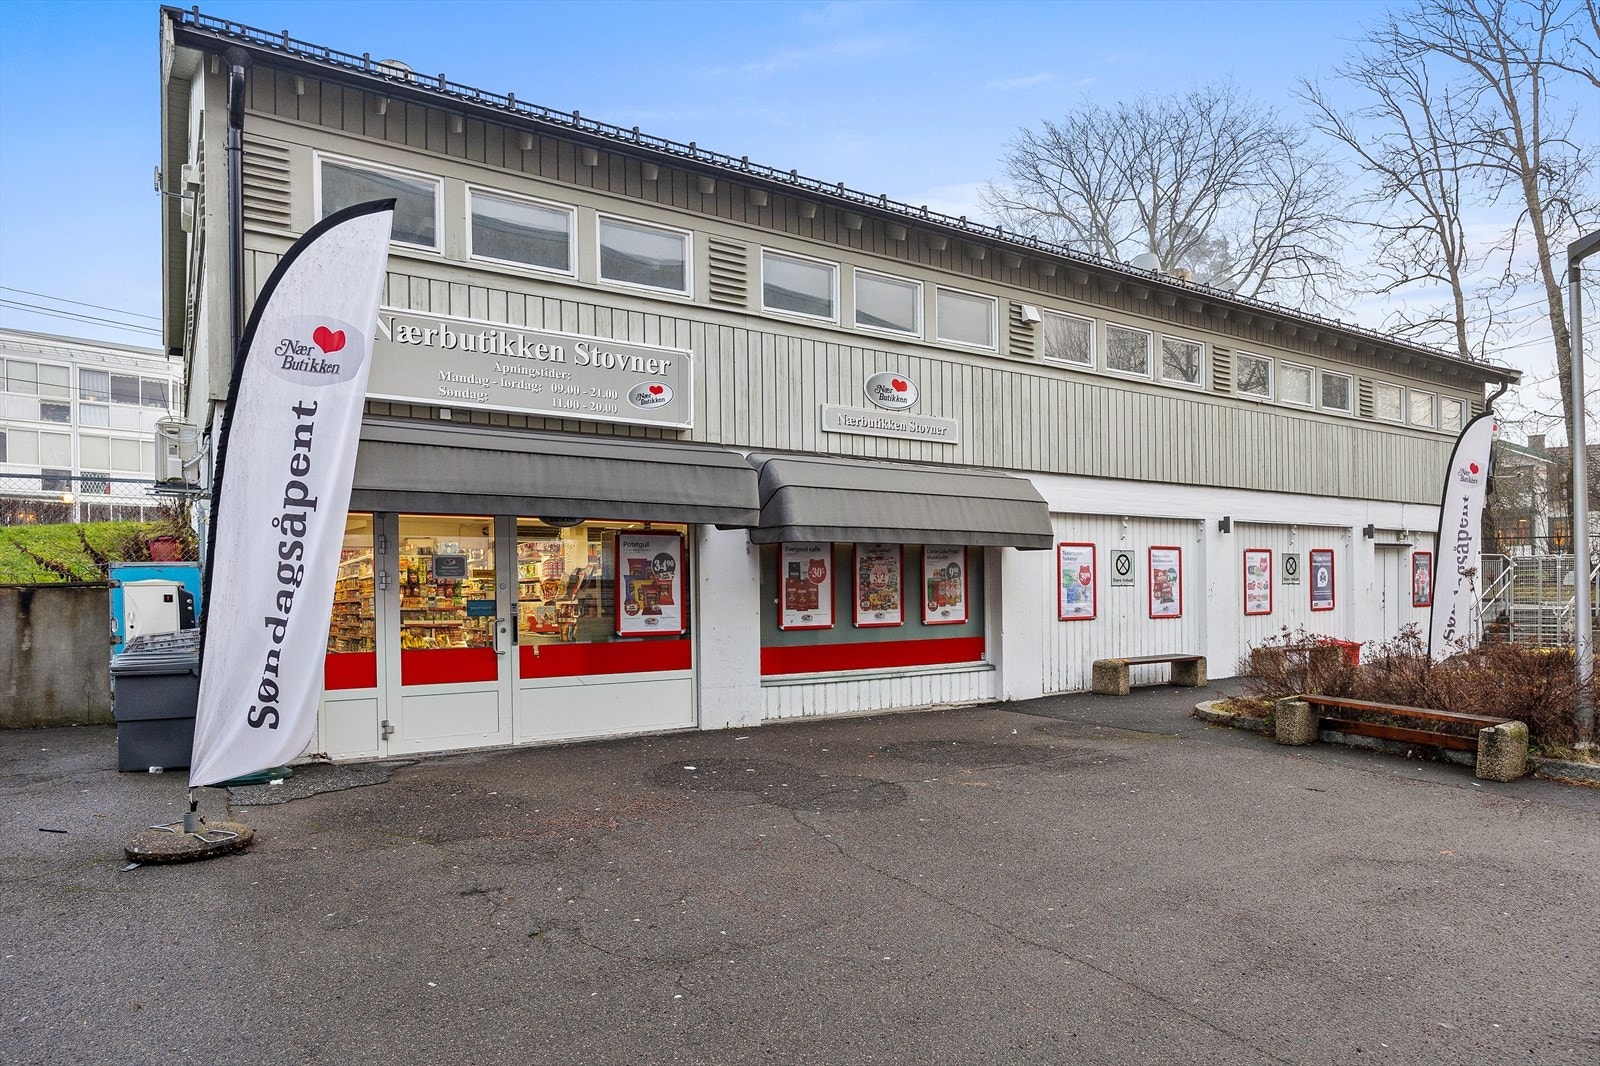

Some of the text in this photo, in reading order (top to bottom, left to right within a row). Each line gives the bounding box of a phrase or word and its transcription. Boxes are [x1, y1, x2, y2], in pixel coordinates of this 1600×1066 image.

[274, 338, 315, 356] Nær
[374, 315, 672, 376] Nærbutikken Stovner
[281, 355, 340, 375] Butikken
[492, 360, 572, 381] Åpningstider:
[438, 370, 490, 389] Mandag
[500, 377, 543, 393] lørdag:
[551, 383, 580, 396] 09.00
[590, 387, 618, 400] 21.00
[438, 385, 489, 402] Søndag:
[874, 384, 893, 394] Nær
[551, 397, 580, 410] 11.00
[590, 401, 618, 414] 20.00
[879, 392, 908, 403] Butikken
[837, 413, 947, 436] Nærbutikken Stovner
[246, 399, 319, 730] Søndagsåpent
